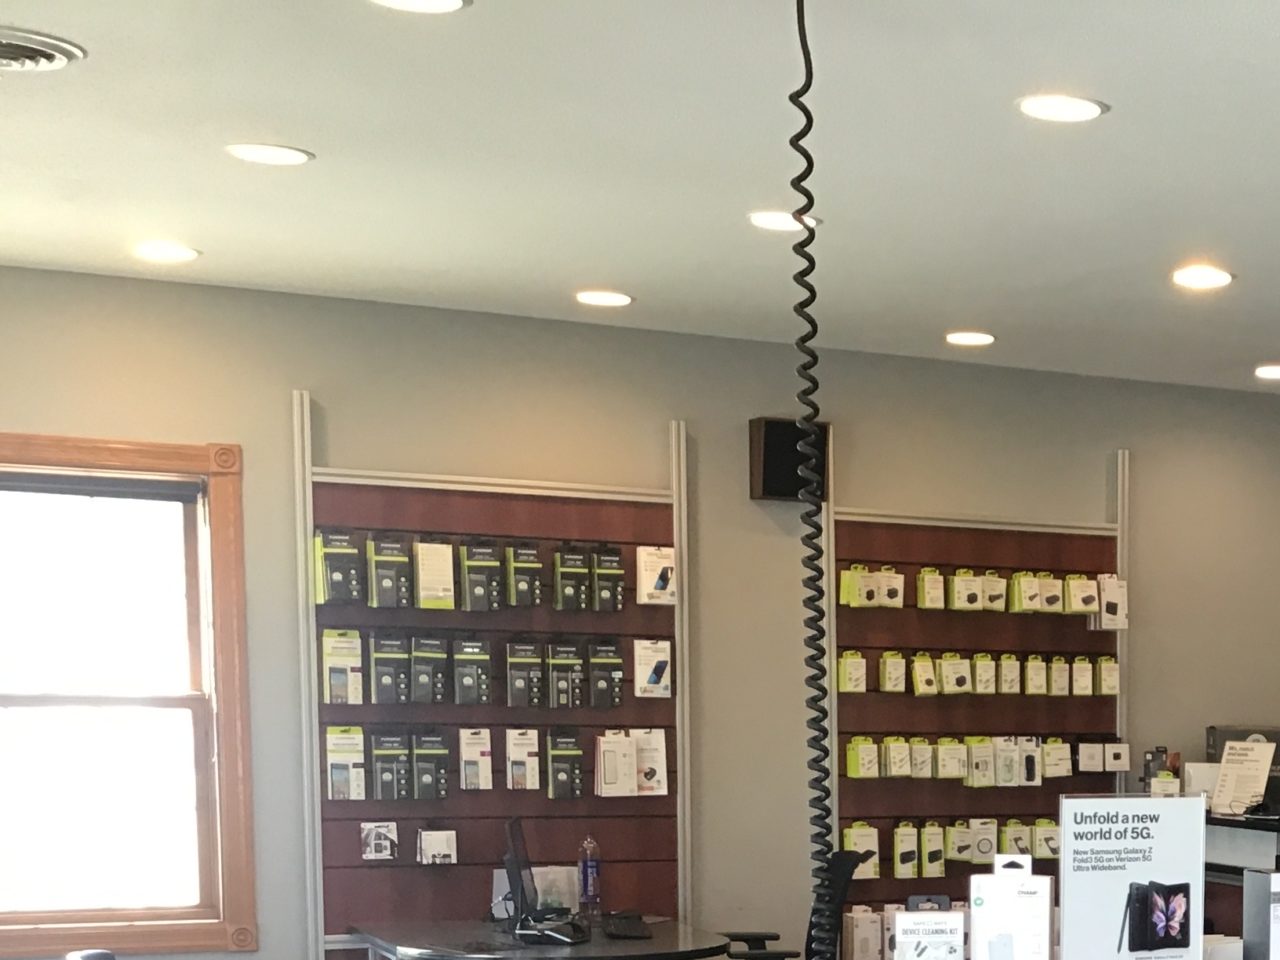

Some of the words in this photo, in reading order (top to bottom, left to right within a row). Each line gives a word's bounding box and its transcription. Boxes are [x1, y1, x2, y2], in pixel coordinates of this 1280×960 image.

[1073, 812, 1119, 824] Unfold
[1121, 814, 1129, 823] a
[1131, 813, 1160, 823] new
[1073, 828, 1112, 840] world
[1114, 828, 1128, 840] of
[1130, 827, 1154, 840] 5G.
[1090, 848, 1122, 858] Samsung
[1123, 848, 1147, 857] Galaxy
[1073, 856, 1093, 864] Fold3
[1116, 855, 1141, 863] Verizon
[1073, 864, 1090, 872] Ultra
[902, 928, 921, 936] DEVICE
[922, 928, 948, 936] CLEANING
[949, 928, 958, 936] KIT
